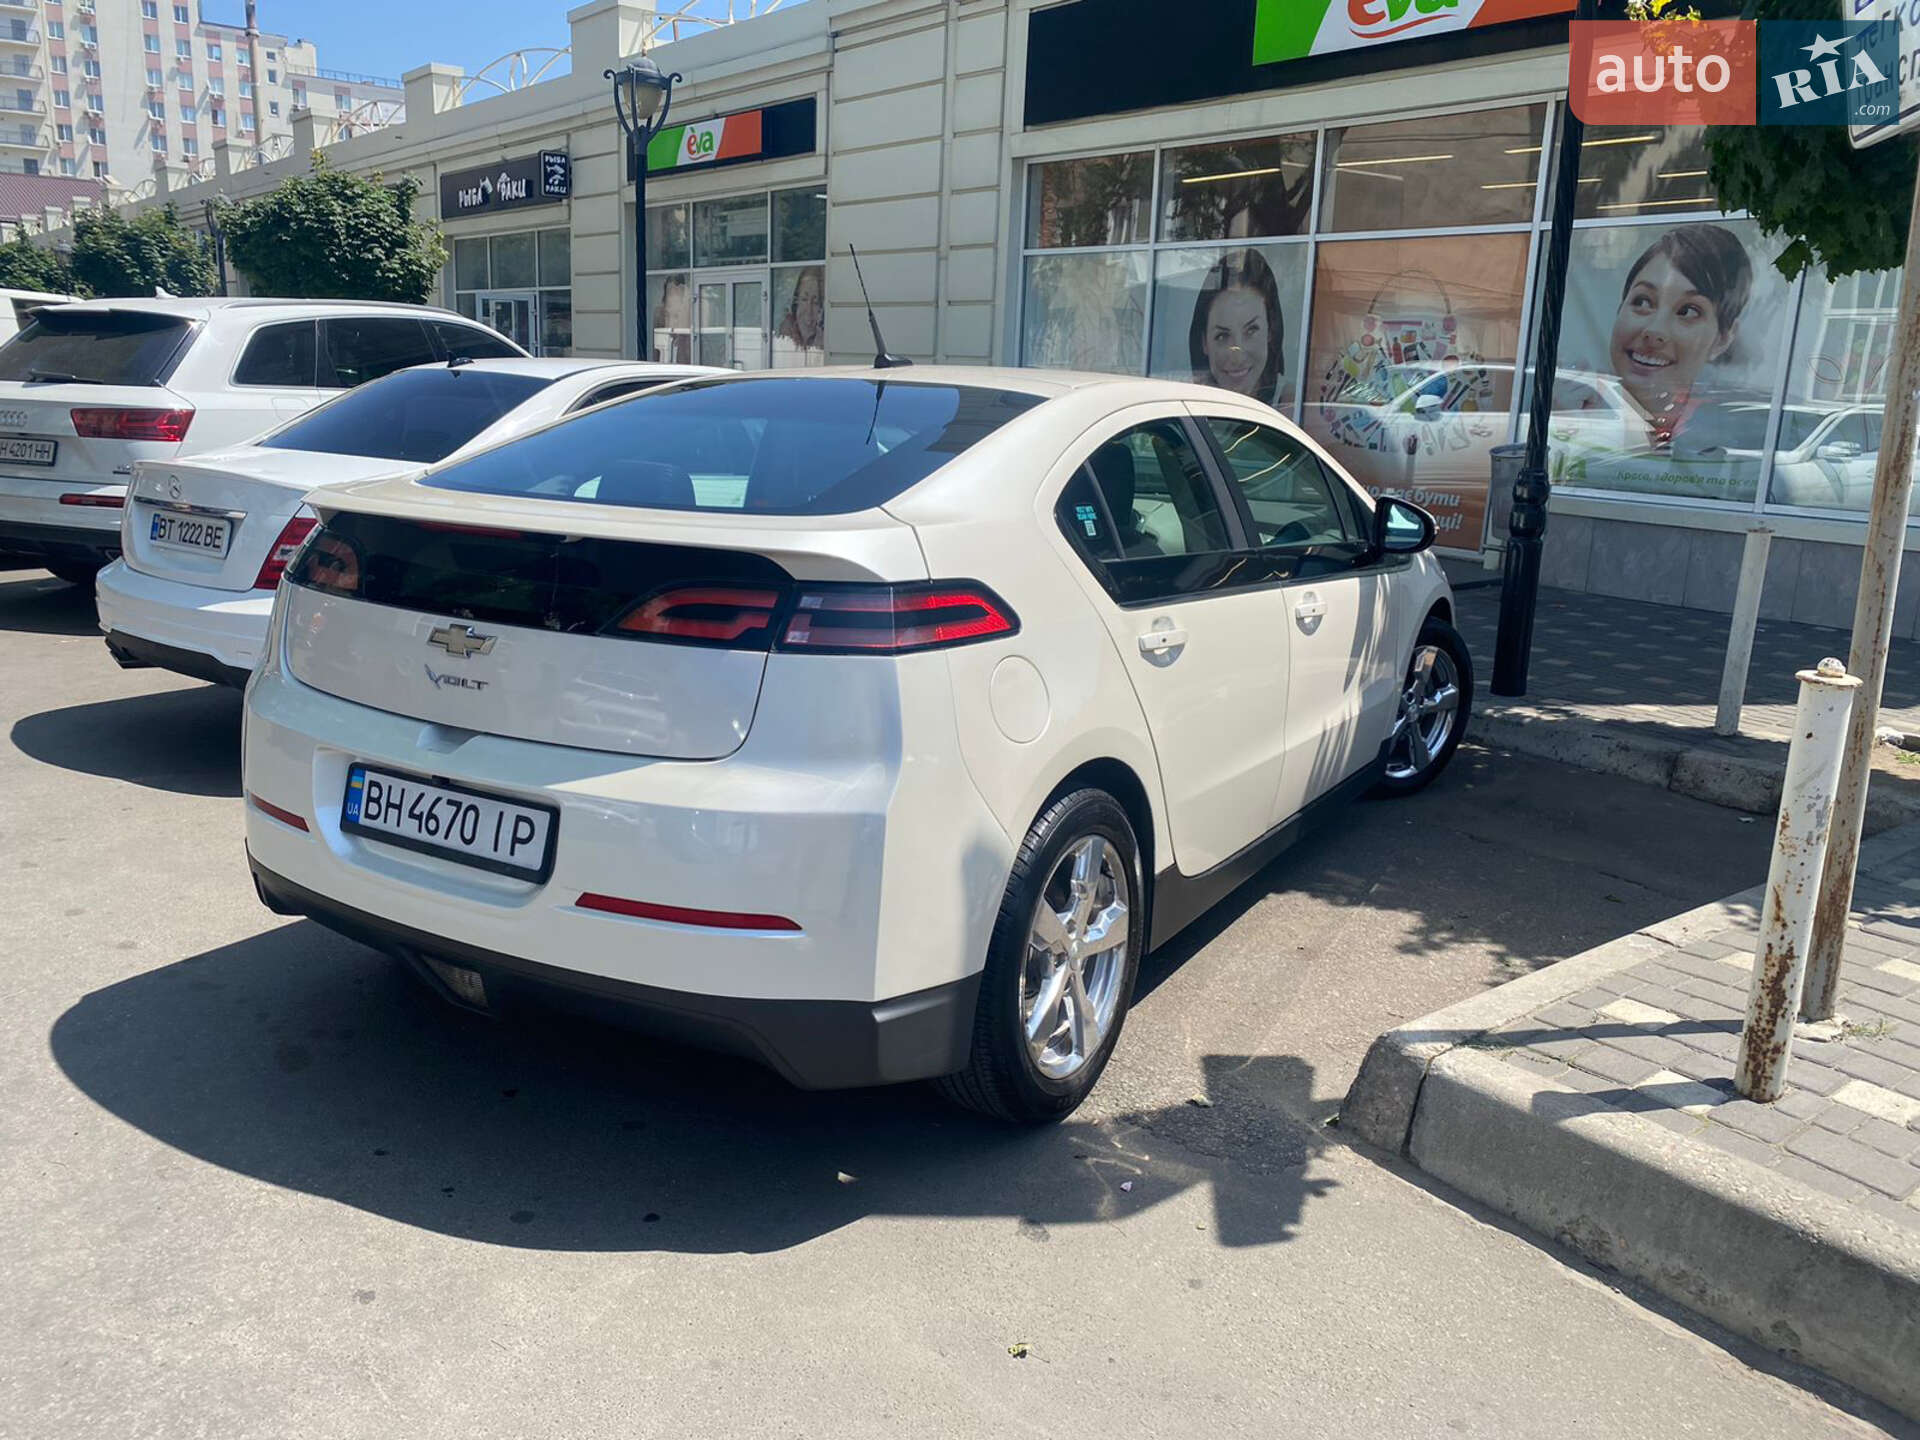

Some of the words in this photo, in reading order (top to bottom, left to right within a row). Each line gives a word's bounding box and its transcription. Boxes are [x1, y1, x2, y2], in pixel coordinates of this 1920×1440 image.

[458, 186, 484, 209] РЫБА
[9, 442, 33, 460] 4201
[158, 517, 176, 540] BT
[177, 521, 204, 546] 1222
[203, 525, 224, 549] BE
[424, 663, 489, 691] VOLT
[346, 802, 360, 817] UA
